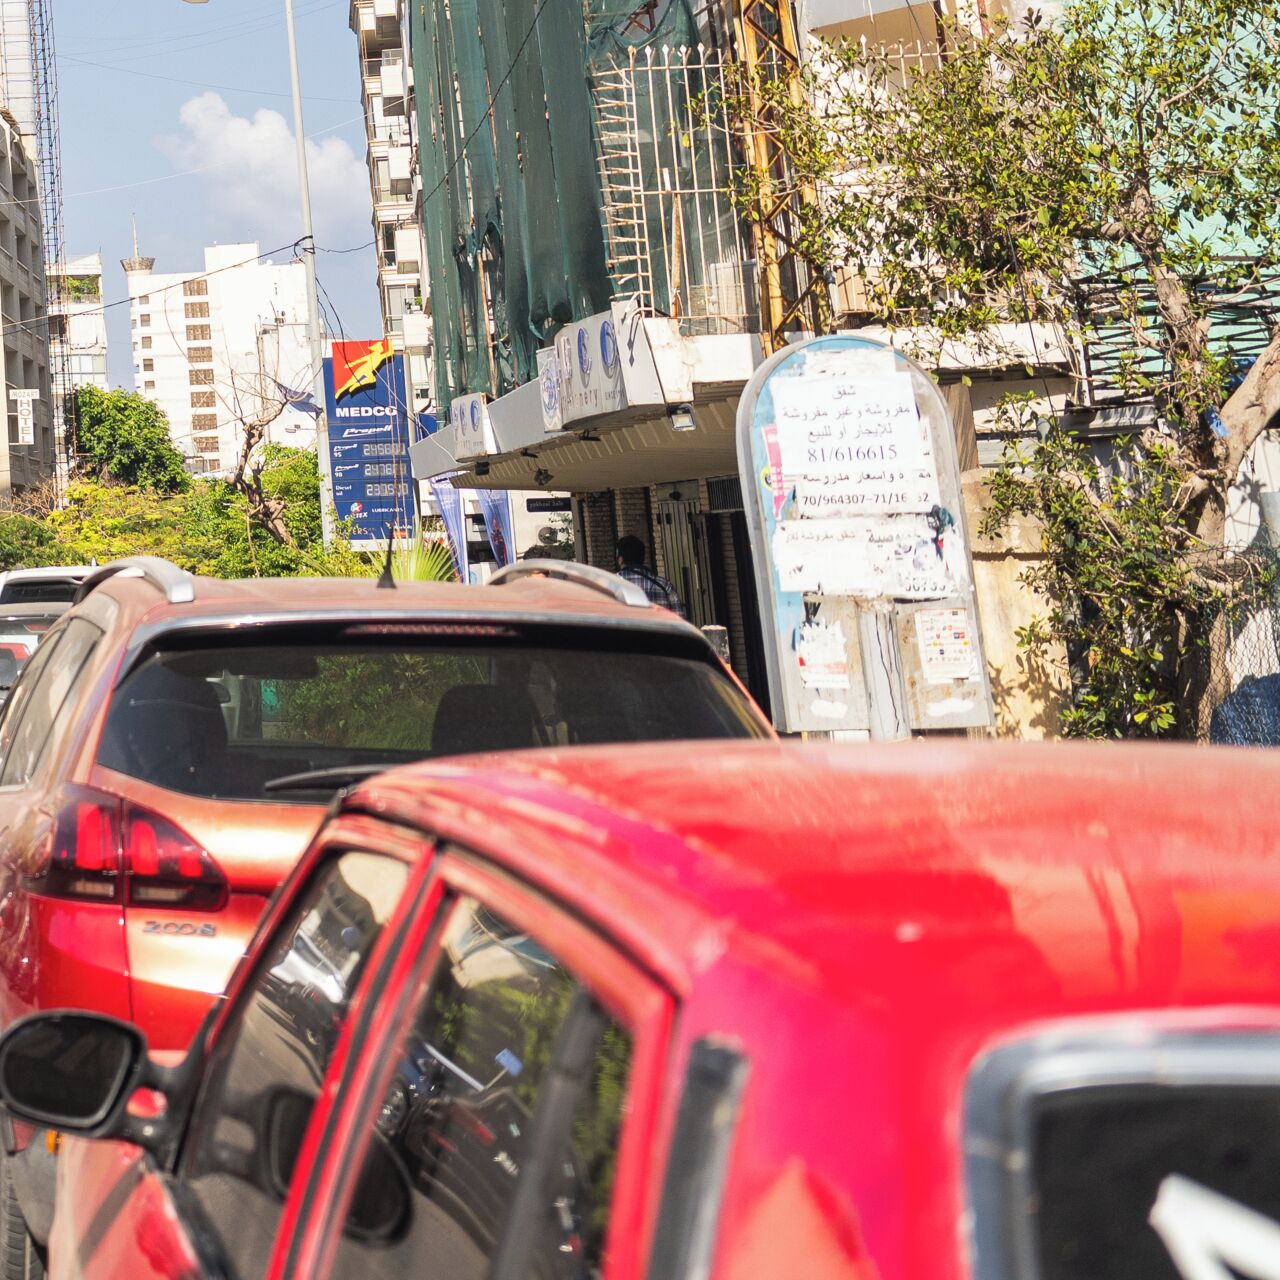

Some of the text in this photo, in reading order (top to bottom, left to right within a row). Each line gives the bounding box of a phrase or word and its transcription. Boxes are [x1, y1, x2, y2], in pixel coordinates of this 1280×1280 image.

[335, 405, 398, 418] MEDCO
[19, 399, 32, 444] HOTEL
[343, 424, 393, 438] Propell
[807, 443, 898, 464] 81/616615
[344, 511, 369, 520] CTEX
[142, 920, 217, 938] 2008
